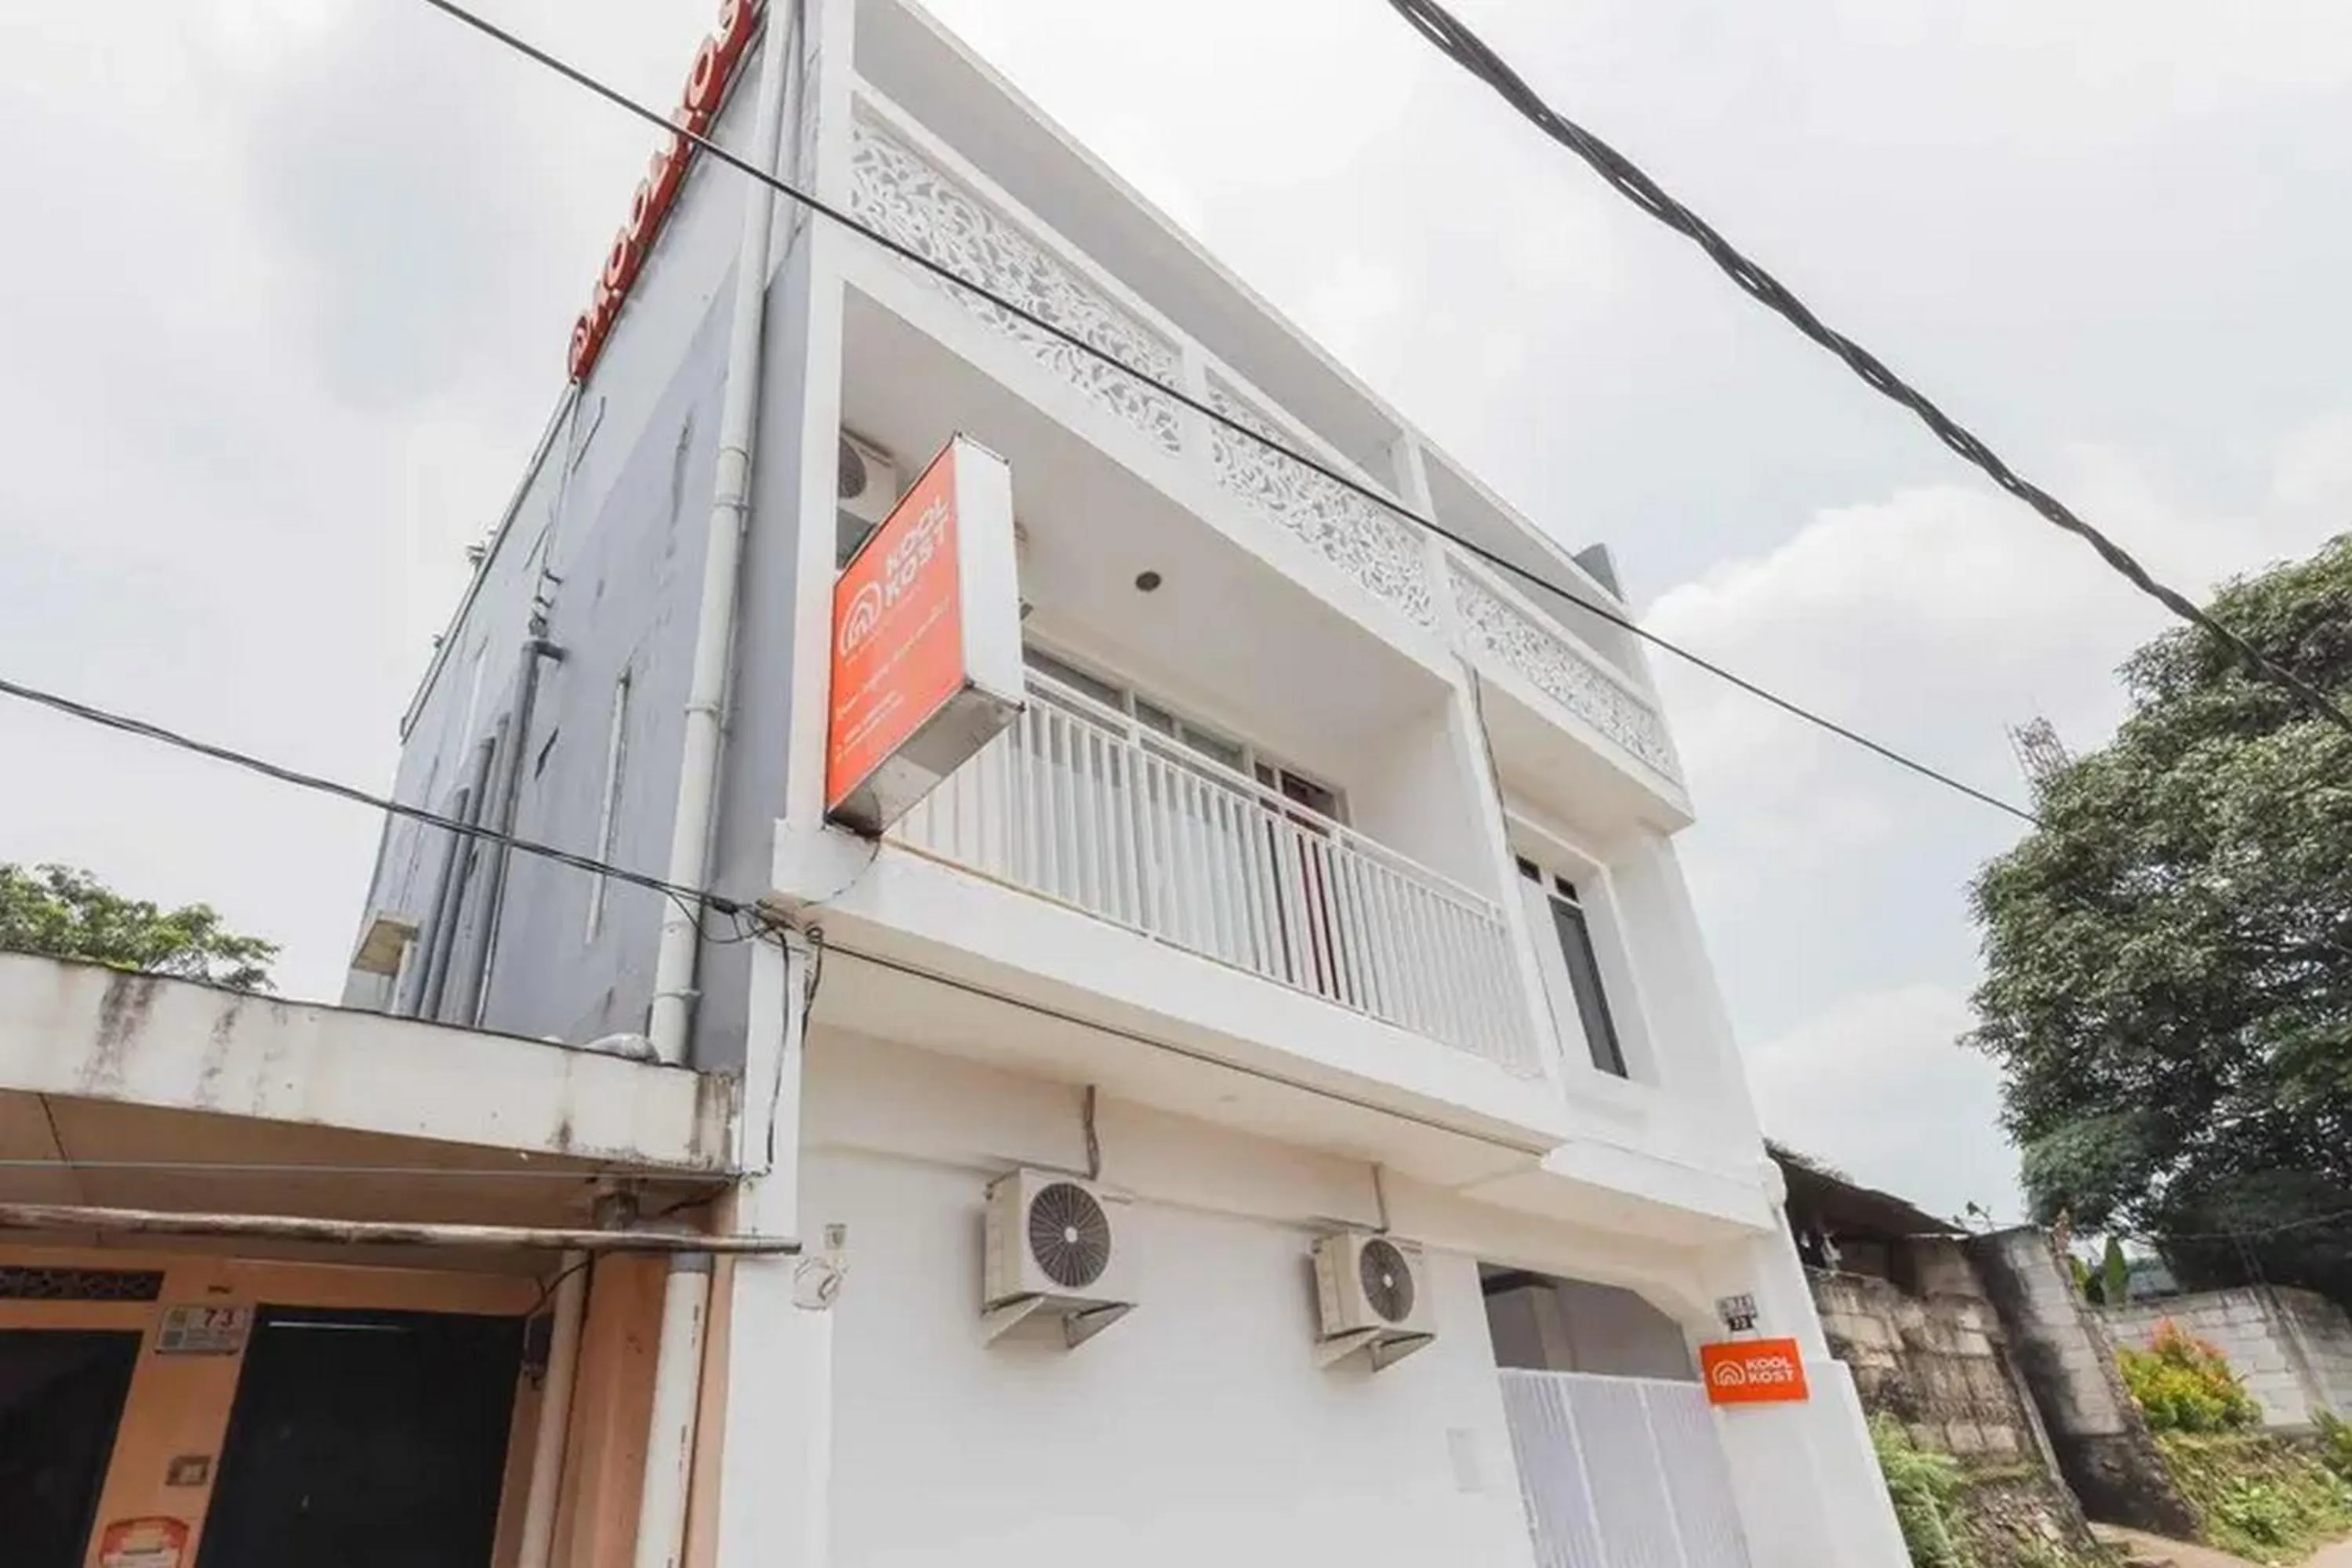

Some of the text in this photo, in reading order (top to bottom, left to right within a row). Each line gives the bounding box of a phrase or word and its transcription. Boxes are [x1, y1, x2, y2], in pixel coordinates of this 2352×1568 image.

[887, 495, 949, 577] KOOL
[885, 514, 949, 607] KOST
[1745, 1356, 1794, 1370] KOOL
[1748, 1370, 1795, 1384] KOST
